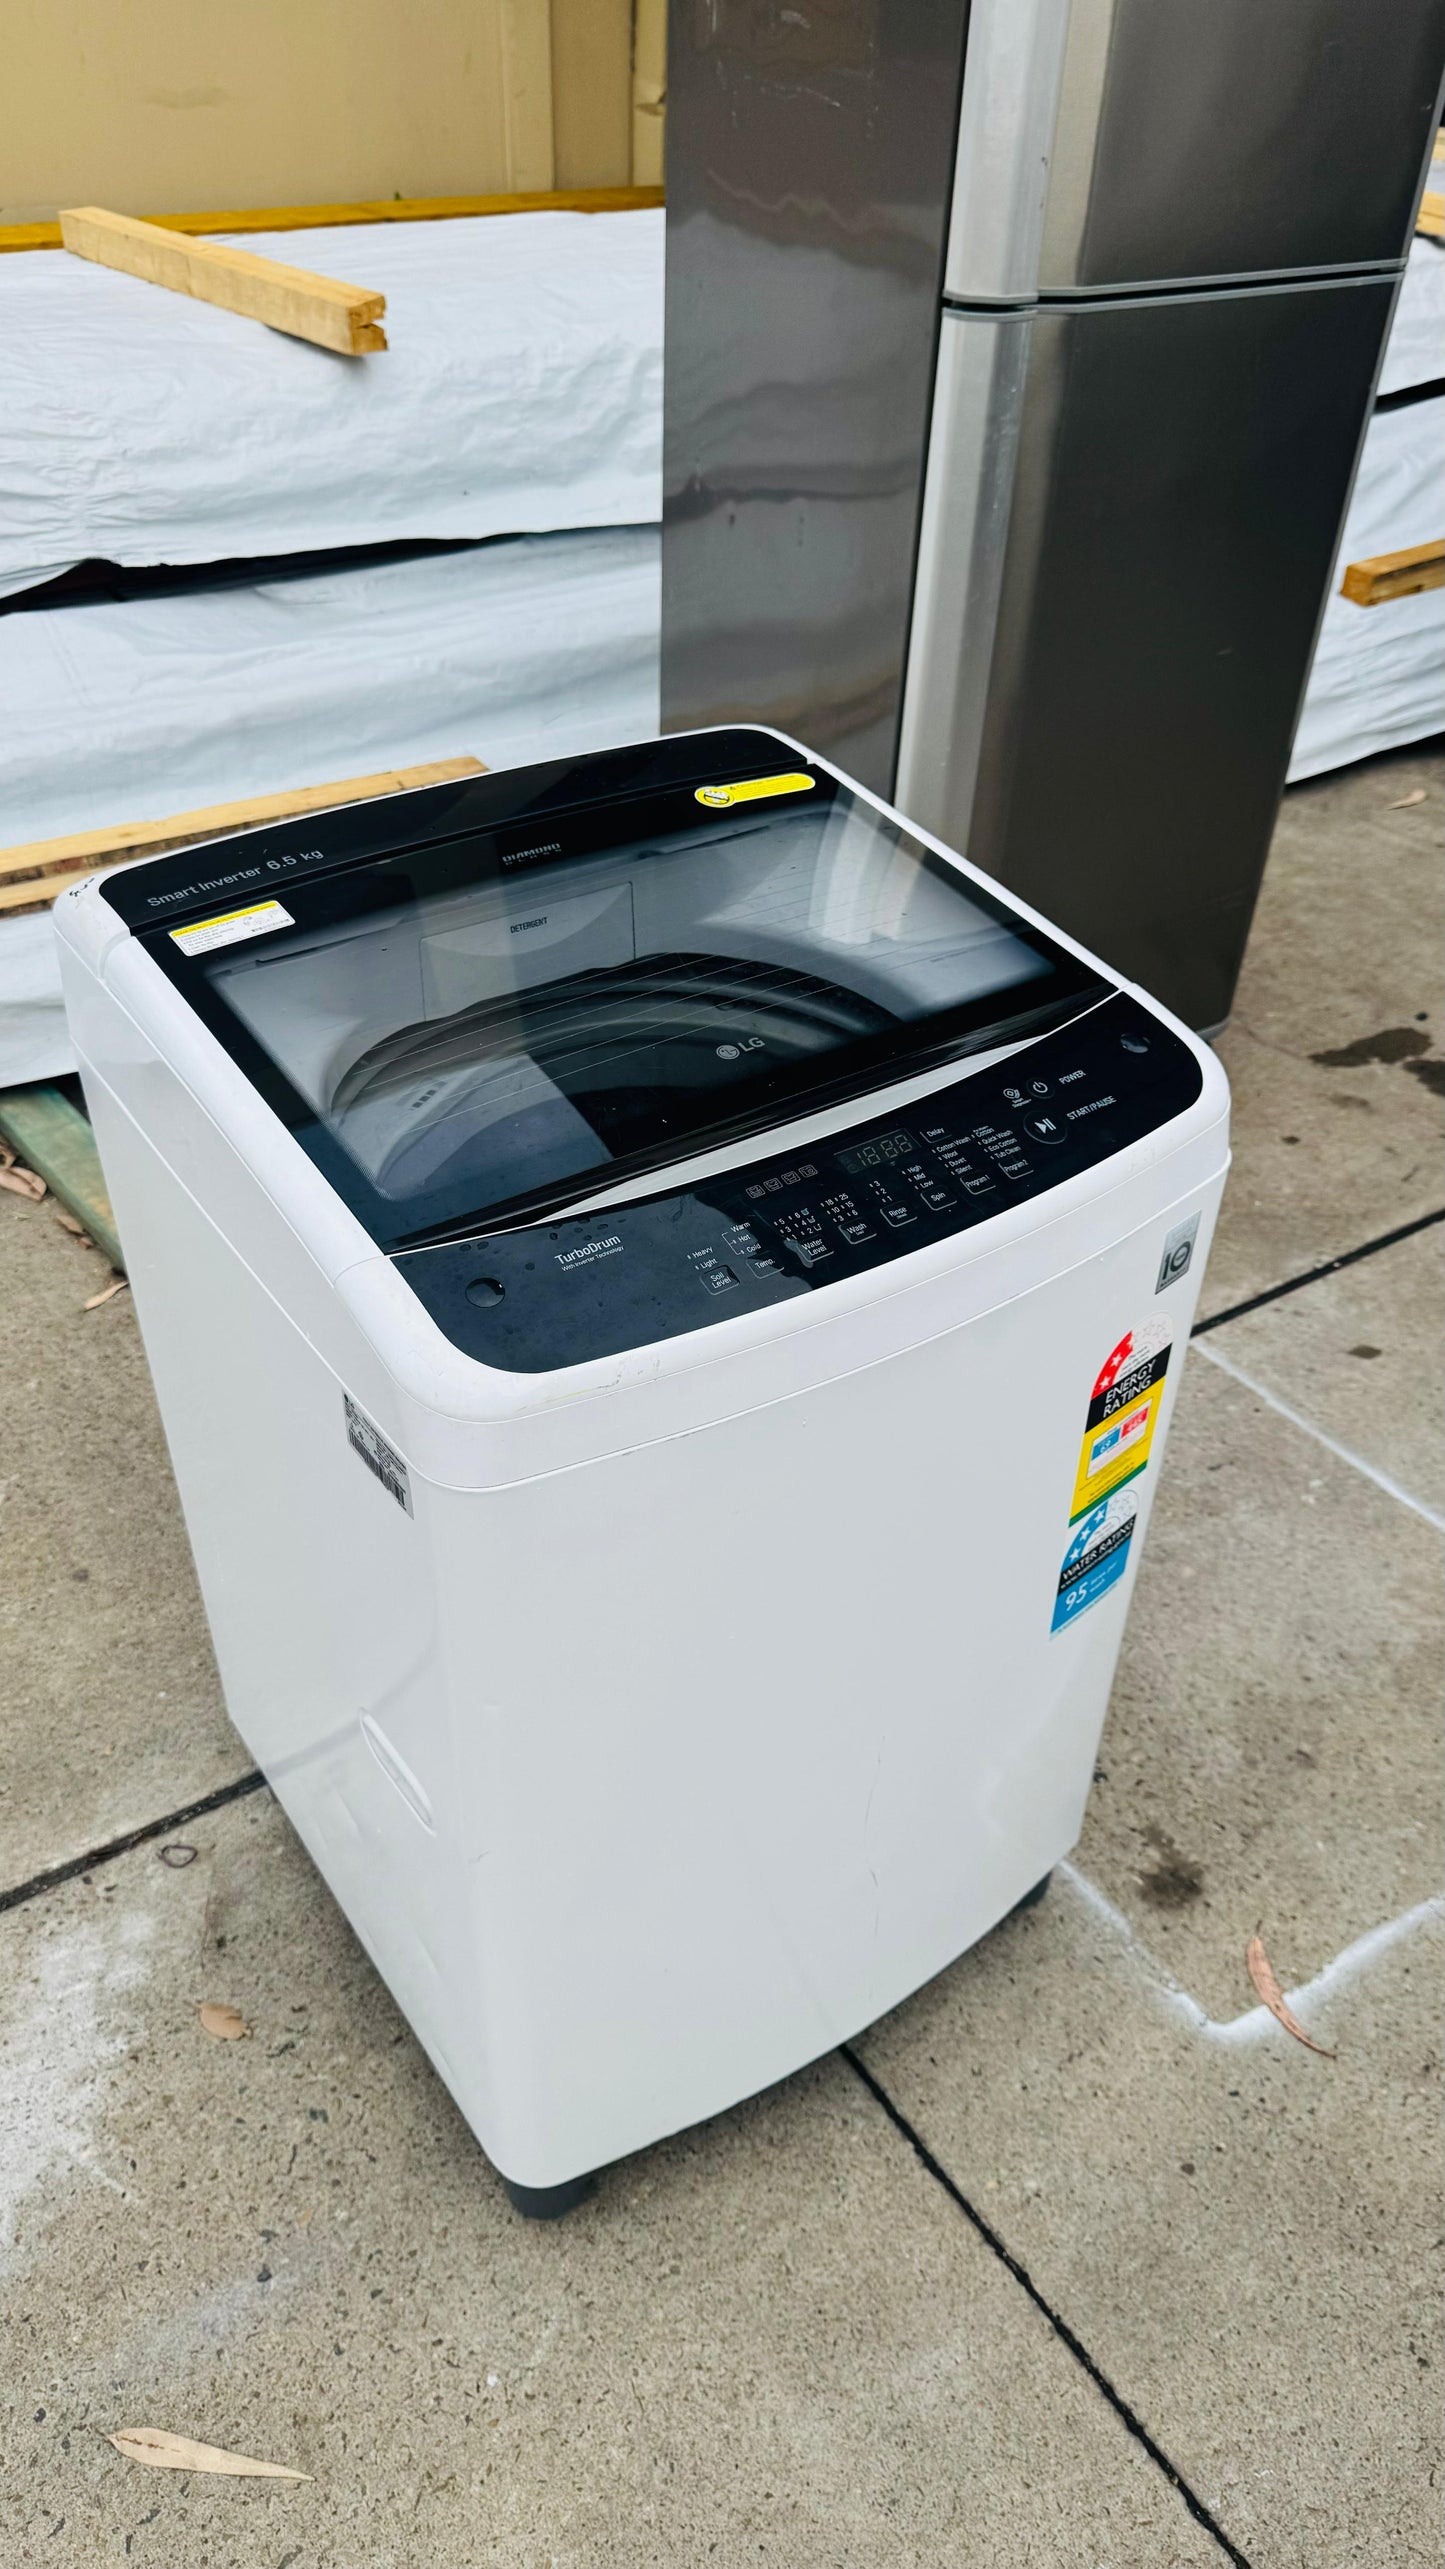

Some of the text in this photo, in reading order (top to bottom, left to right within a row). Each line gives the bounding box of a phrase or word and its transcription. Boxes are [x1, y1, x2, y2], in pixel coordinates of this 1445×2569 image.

[502, 843, 561, 863] DIAMOND
[147, 850, 324, 907] Smart Inverter 6.5 kg
[510, 917, 548, 934] DETERGENT
[737, 1037, 766, 1052] LG
[1059, 1070, 1087, 1084] POWER
[1066, 1096, 1117, 1120] START/PAUSE
[926, 1127, 945, 1137] Delay
[981, 1136, 998, 1145] Quick
[996, 1129, 1013, 1139] Wash
[936, 1136, 971, 1152] Cotton Wash
[987, 1137, 1018, 1152] Eco Cotton
[942, 1150, 958, 1159] Wool
[994, 1150, 1006, 1159] Tub
[949, 1157, 966, 1167] Duvet
[1003, 1161, 1024, 1172] Program
[907, 1164, 922, 1173] High
[955, 1164, 973, 1174] Silent
[914, 1172, 926, 1181] Mid
[965, 1176, 987, 1188] Program
[920, 1180, 934, 1188] Low
[839, 1193, 849, 1201] 25
[930, 1192, 946, 1202] Spin
[831, 1200, 854, 1214] 10 15
[888, 1207, 907, 1217] Rinse
[730, 1221, 751, 1233] Warm
[846, 1223, 867, 1234] Wash
[738, 1234, 751, 1243] Hot
[801, 1238, 823, 1250] Water
[554, 1235, 621, 1264] TurboDrum
[692, 1246, 713, 1258] Heavy
[746, 1243, 762, 1253] Cold
[807, 1244, 827, 1256] Level
[561, 1245, 625, 1272] With Inverter Technology
[700, 1258, 718, 1270] Light
[754, 1258, 775, 1270] Temp.
[710, 1271, 725, 1282] Soil
[711, 1276, 732, 1289] Level
[1105, 1359, 1156, 1404] ENERGY
[1103, 1375, 1152, 1418] RATING
[1098, 1519, 1135, 1555] RATING
[1063, 1550, 1098, 1579] WATER
[1065, 1581, 1088, 1611] 95
